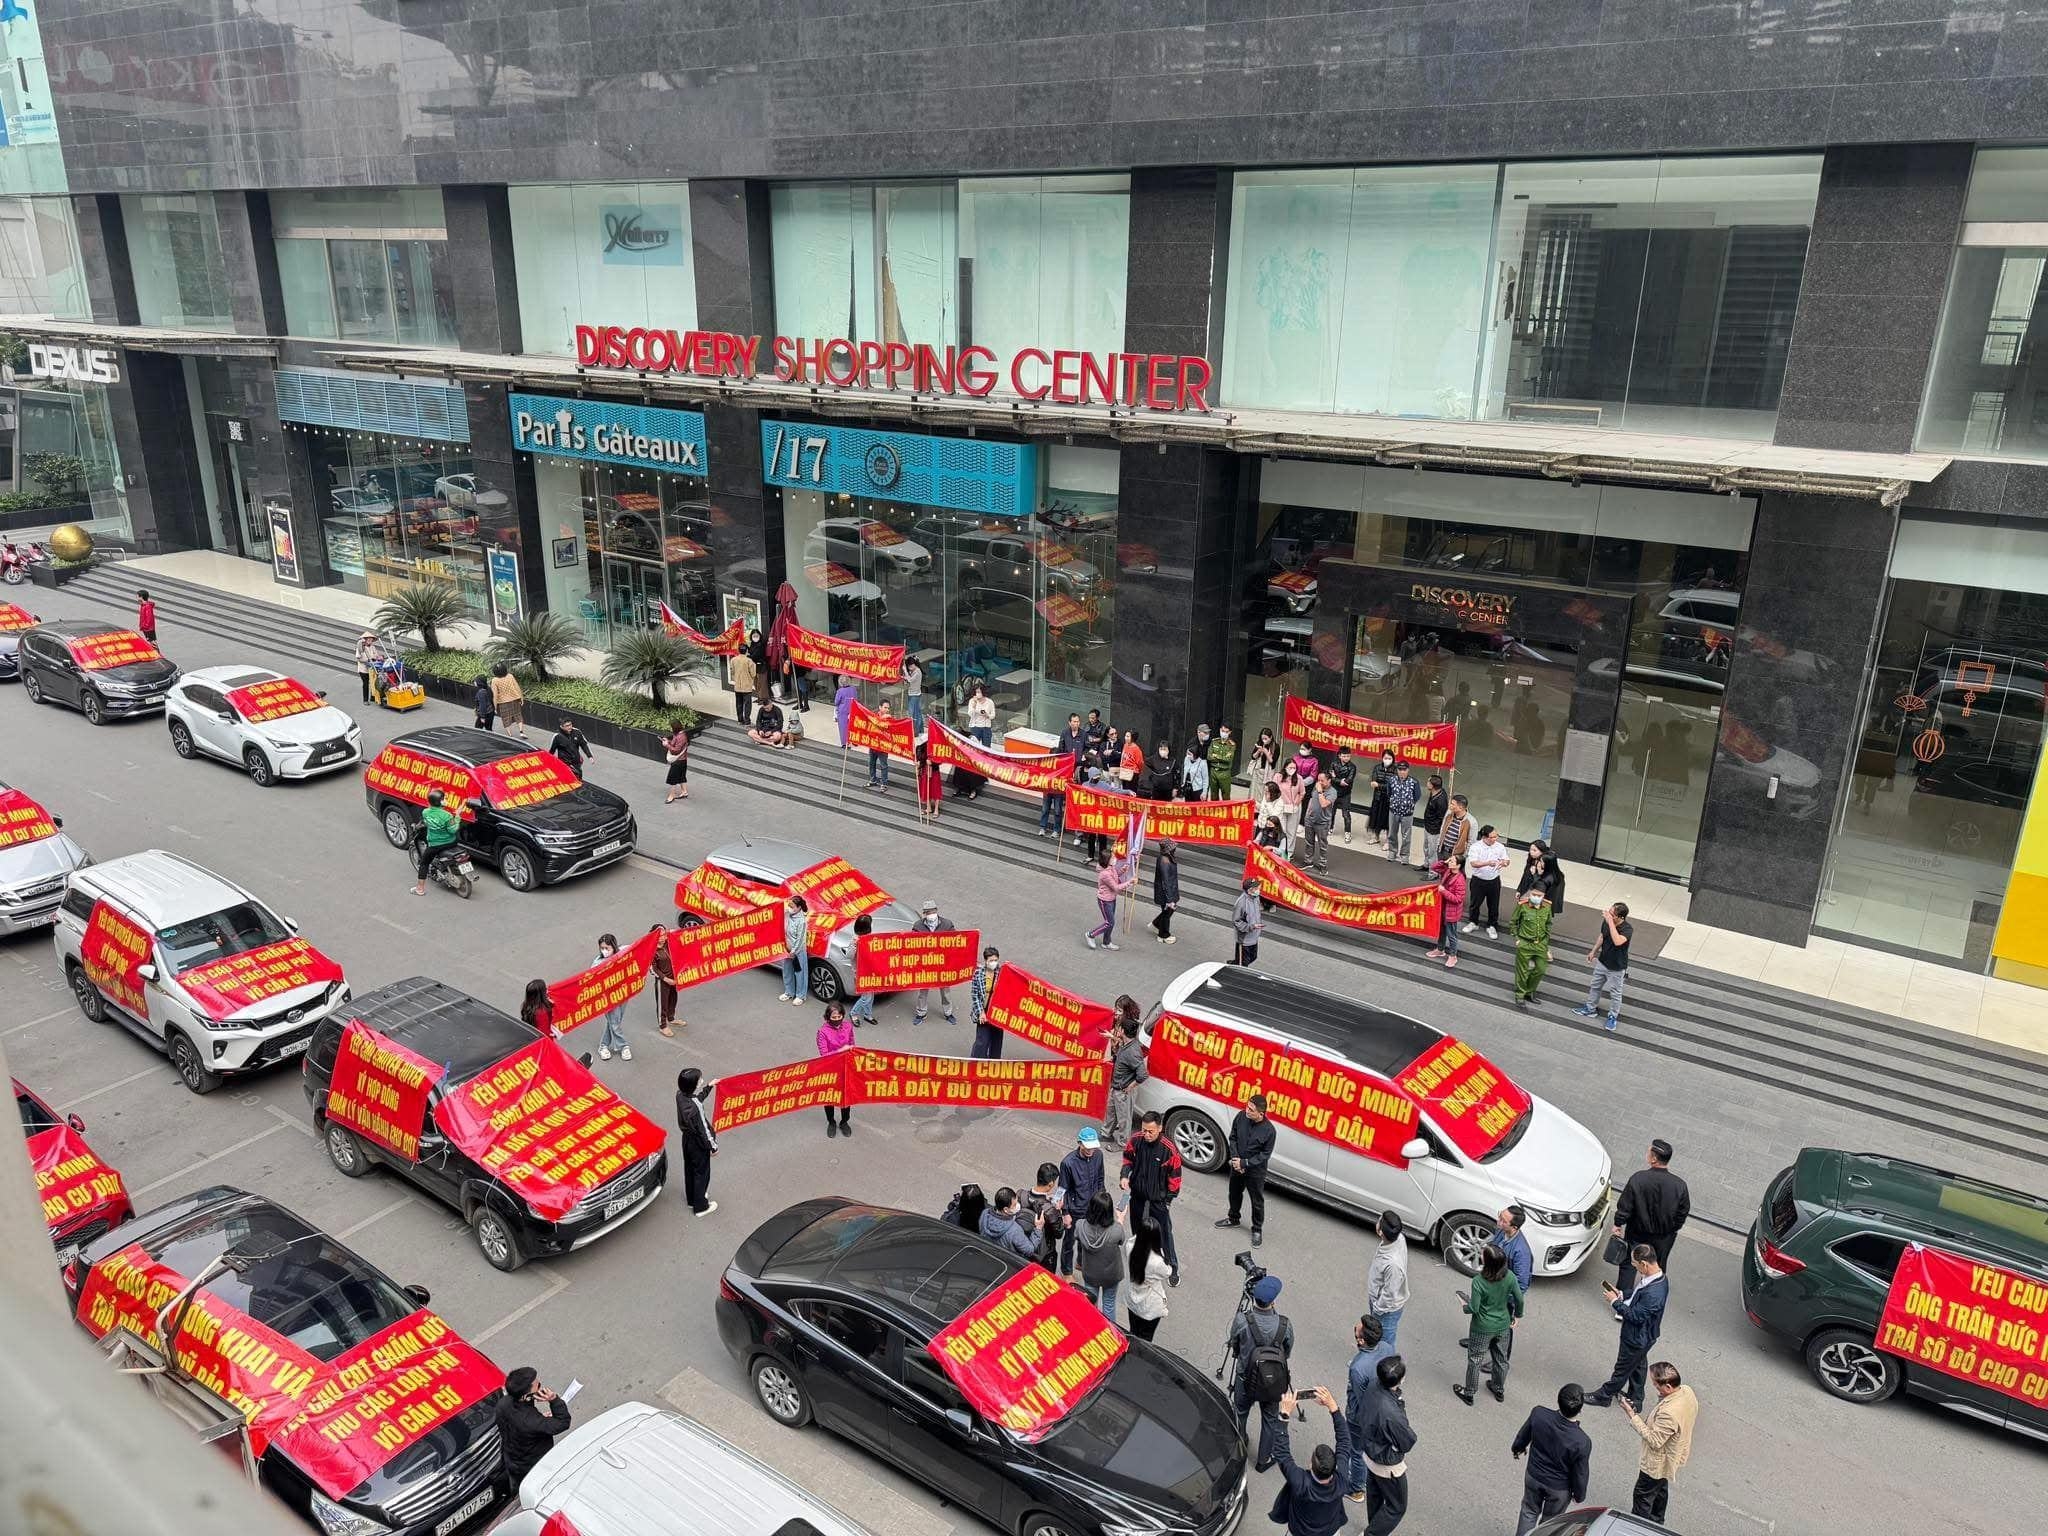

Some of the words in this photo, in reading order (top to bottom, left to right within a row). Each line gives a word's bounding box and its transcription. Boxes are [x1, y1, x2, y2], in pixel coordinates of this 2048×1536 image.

[28, 344, 120, 383] DEXUS
[575, 325, 761, 379] DISCOVERY
[772, 334, 999, 397] SHOPPING
[1011, 348, 1213, 412] CENTER
[517, 409, 585, 450] Paris
[593, 423, 698, 466] Gâteaux
[1412, 584, 1517, 612] DISCOVERY
[1470, 612, 1508, 624] CENTER
[1403, 744, 1427, 761] CĂN
[1431, 749, 1448, 764] CỨ
[7, 807, 39, 822] MINH
[13, 825, 30, 840] CƯ
[31, 822, 55, 837] DÂN
[1080, 811, 1103, 828] TRẢ
[1159, 818, 1184, 835] QUỸ
[1188, 823, 1214, 837] BẢO
[1220, 824, 1240, 840] TRÌ
[1367, 907, 1396, 926] BẢO
[1403, 912, 1425, 929] TRÌ
[183, 972, 207, 987] YÊU
[207, 964, 232, 978] CẦU
[255, 944, 292, 961] CHẤM
[701, 942, 713, 957] KÝ
[753, 946, 770, 960] CHO
[889, 954, 902, 968] KÝ
[903, 954, 919, 967] HỢP
[213, 978, 240, 993] THU
[239, 969, 265, 984] CÁC
[264, 961, 292, 976] LOẠI
[290, 953, 314, 966] PHÍ
[245, 986, 265, 1000] VÔ
[264, 978, 291, 993] CĂN
[289, 972, 309, 985] CỨ
[884, 973, 895, 986] LÝ
[915, 970, 938, 983] HÀNH
[940, 969, 957, 981] CHO
[1064, 1038, 1084, 1057] BẢO
[469, 1083, 497, 1109] YÊU
[493, 1071, 517, 1093] CẦU
[515, 1056, 540, 1080] CĐT
[761, 1070, 782, 1084] YÊU
[854, 1052, 888, 1073] YÊU
[893, 1054, 931, 1074] CẦU
[936, 1059, 969, 1077] CĐT
[1032, 1062, 1075, 1080] KHAI
[1080, 1065, 1103, 1085] VÀ
[1161, 1017, 1189, 1044] YÊU
[1192, 1027, 1227, 1060] CẦU
[1228, 1036, 1265, 1072] ÔNG
[1269, 1052, 1314, 1090] TRẦN
[1317, 1068, 1358, 1104] ĐỨC
[1359, 1087, 1416, 1125] MINH
[489, 1103, 524, 1132] CÔNG
[521, 1088, 551, 1114] KHAI
[543, 1077, 565, 1098] VÀ
[714, 1111, 733, 1131] TRẢ
[754, 1100, 771, 1118] ĐỎ
[772, 1095, 796, 1112] CHO
[798, 1091, 815, 1105] CƯ
[817, 1088, 842, 1104] DÂN
[722, 1094, 745, 1111] ÔNG
[750, 1084, 779, 1105] TRẦN
[781, 1079, 803, 1094] ĐỨC
[807, 1072, 838, 1087] MINH
[865, 1075, 899, 1097] TRẢ
[905, 1078, 942, 1098] ĐẦY
[947, 1080, 971, 1099] ĐỦ
[977, 1082, 1013, 1101] QUỸ
[1018, 1082, 1055, 1104] BẢO
[1061, 1089, 1090, 1109] TRÌ
[1177, 1059, 1209, 1089] TRẢ
[1211, 1071, 1236, 1098] SỔ
[1265, 1090, 1301, 1121] CHO
[1303, 1102, 1333, 1133] CƯ
[1334, 1116, 1376, 1151] DÂN
[481, 1140, 512, 1168] TRẢ
[504, 1127, 534, 1153] ĐẦY
[529, 1118, 551, 1140] ĐỦ
[544, 1107, 570, 1131] QUỸ
[566, 1097, 594, 1119] BẢO
[587, 1083, 612, 1104] TRÌ
[507, 1162, 535, 1183] YÊU
[530, 1145, 555, 1167] CẦU
[555, 1135, 580, 1153] CĐT
[576, 1116, 613, 1139] CHẤM
[608, 1104, 633, 1121] DỨT
[52, 1153, 98, 1181] MINH
[543, 1164, 569, 1184] THU
[567, 1148, 592, 1169] CÁC
[592, 1134, 618, 1156] LOẠI
[614, 1122, 637, 1140] PHÍ
[576, 1168, 599, 1188] VÔ
[596, 1153, 623, 1176] CĂN
[619, 1142, 638, 1163] CỨ
[66, 1183, 92, 1207] CƯ
[92, 1172, 122, 1196] DÂN
[1970, 1264, 2007, 1299] YÊU
[2008, 1279, 2048, 1314] CẦU
[89, 1291, 117, 1331] TRẢ
[944, 1335, 976, 1366] YÊU
[965, 1318, 998, 1349] CẦU
[986, 1289, 1034, 1332] CHUYỂN
[1021, 1271, 1061, 1305] QUYỀN
[1904, 1281, 1943, 1324] ÔNG
[1947, 1301, 1996, 1341] TRẦN
[1997, 1319, 2038, 1356] ĐỨC
[216, 1327, 279, 1378] KHAI
[270, 1361, 316, 1402] VÀ
[338, 1355, 376, 1389] CĐT
[371, 1329, 424, 1372] CHẤM
[416, 1311, 453, 1344] DỨT
[998, 1347, 1024, 1380] KÝ
[1012, 1335, 1043, 1365] HỢP
[1032, 1315, 1070, 1350] ĐỒNG
[1883, 1322, 1919, 1353] TRẢ
[1920, 1336, 1950, 1363] SỔ
[1948, 1344, 1978, 1374] ĐỎ
[1978, 1358, 2019, 1389] CHO
[319, 1411, 360, 1445] THU
[355, 1389, 395, 1422] CÁC
[391, 1363, 432, 1400] LOẠI
[423, 1346, 460, 1377] PHÍ
[1020, 1386, 1045, 1420] LÝ
[1055, 1357, 1091, 1390] HÀNH
[1080, 1340, 1109, 1368] CHO
[371, 1421, 405, 1452] VÔ
[398, 1400, 440, 1434] CĂN
[431, 1383, 463, 1412] CỨ
